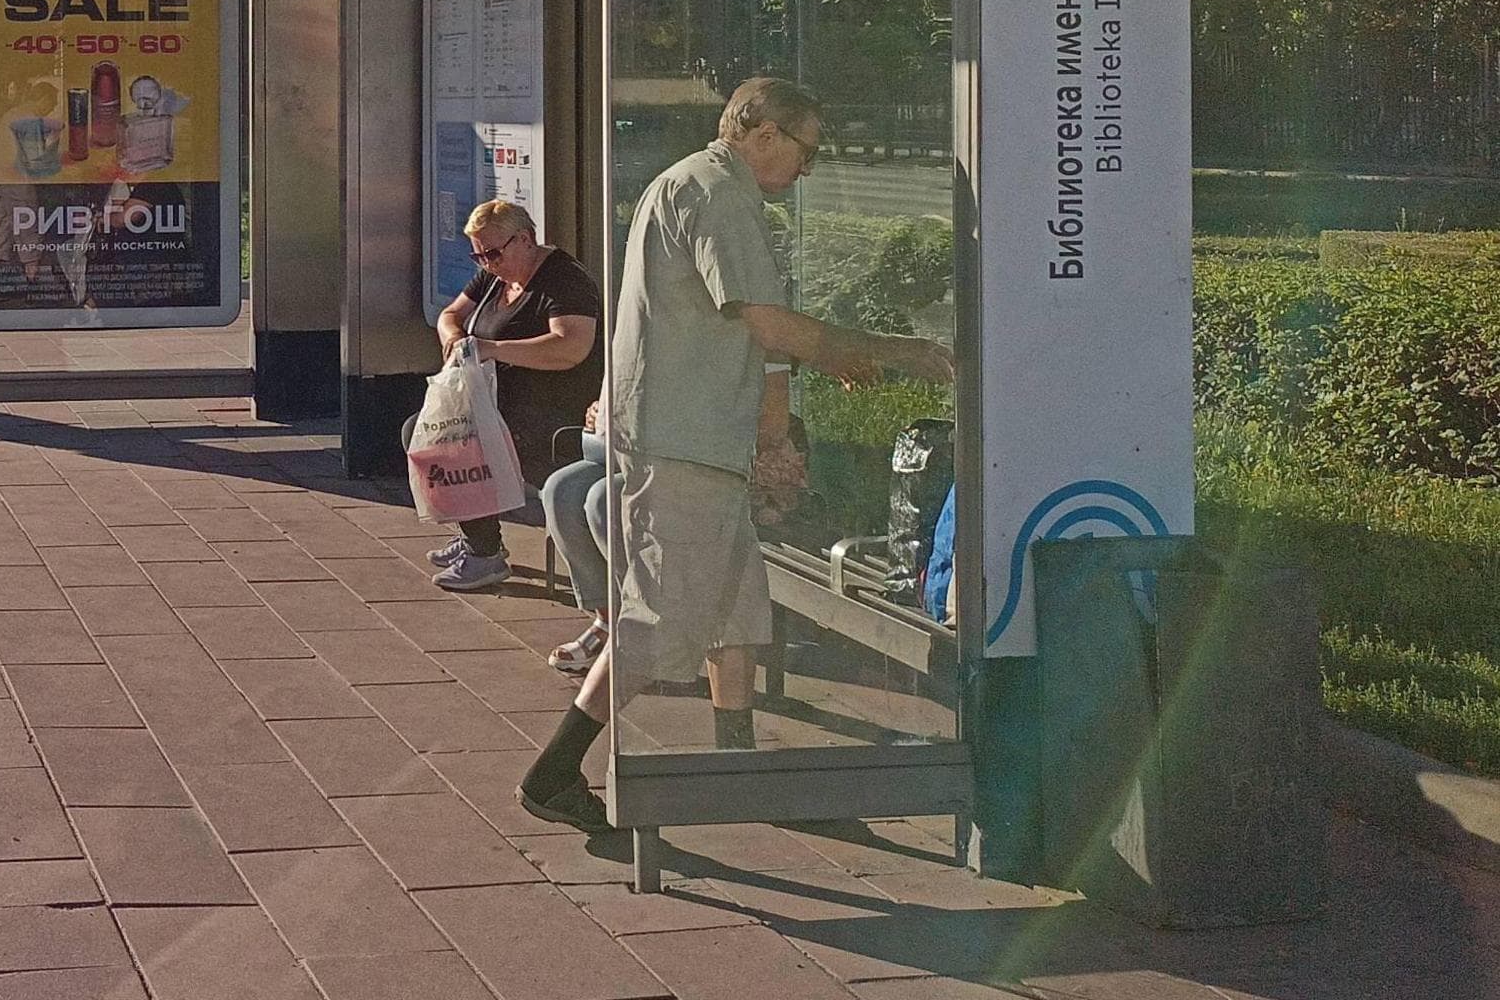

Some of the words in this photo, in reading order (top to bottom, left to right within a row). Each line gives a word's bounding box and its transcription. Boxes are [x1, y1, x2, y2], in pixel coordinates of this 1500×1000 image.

[1095, 19, 1122, 172] Biblioteka
[12, 205, 93, 236] РИВ
[103, 203, 186, 235] ГОШ
[1048, 86, 1084, 279] Библиотека
[12, 242, 96, 252] ПАРФЮМЕРИЯ
[100, 242, 109, 251] И
[113, 240, 186, 251] КОСМЕТИКА
